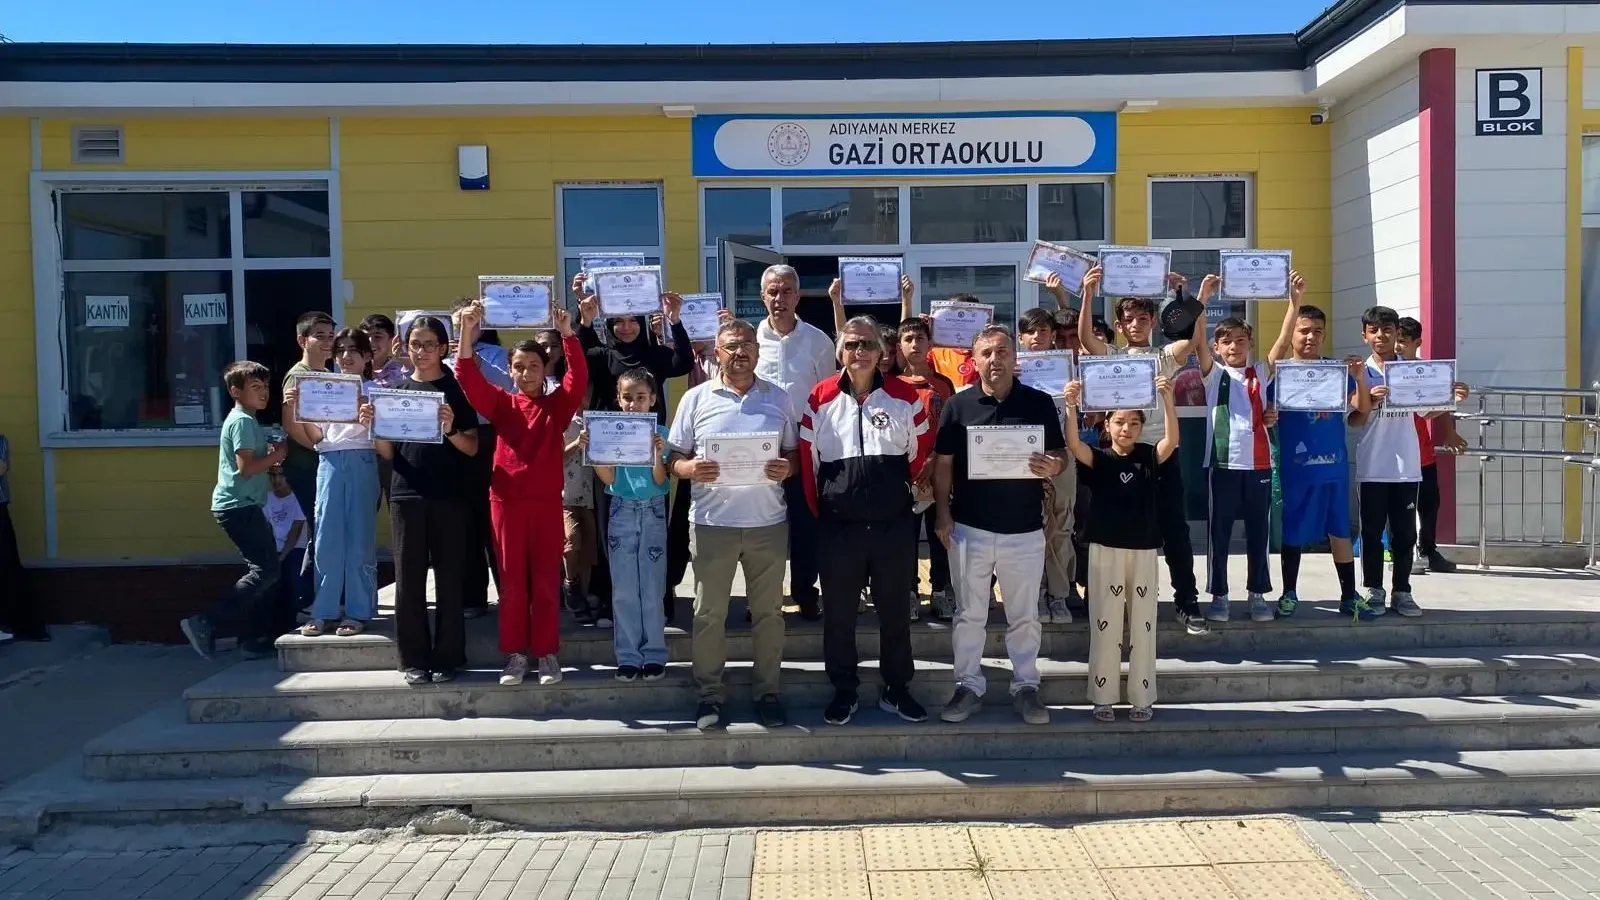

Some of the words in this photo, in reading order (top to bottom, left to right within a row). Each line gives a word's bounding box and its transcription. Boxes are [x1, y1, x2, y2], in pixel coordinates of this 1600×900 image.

[1489, 73, 1531, 118] B
[829, 122, 898, 135] ADIYAMAN
[902, 122, 956, 134] MERKEZ
[1482, 122, 1536, 132] BLOK
[828, 137, 883, 165] GAZİ
[892, 141, 1043, 164] ORTAOKULU
[87, 301, 128, 320] KANTİN
[185, 298, 226, 318] KANTİN
